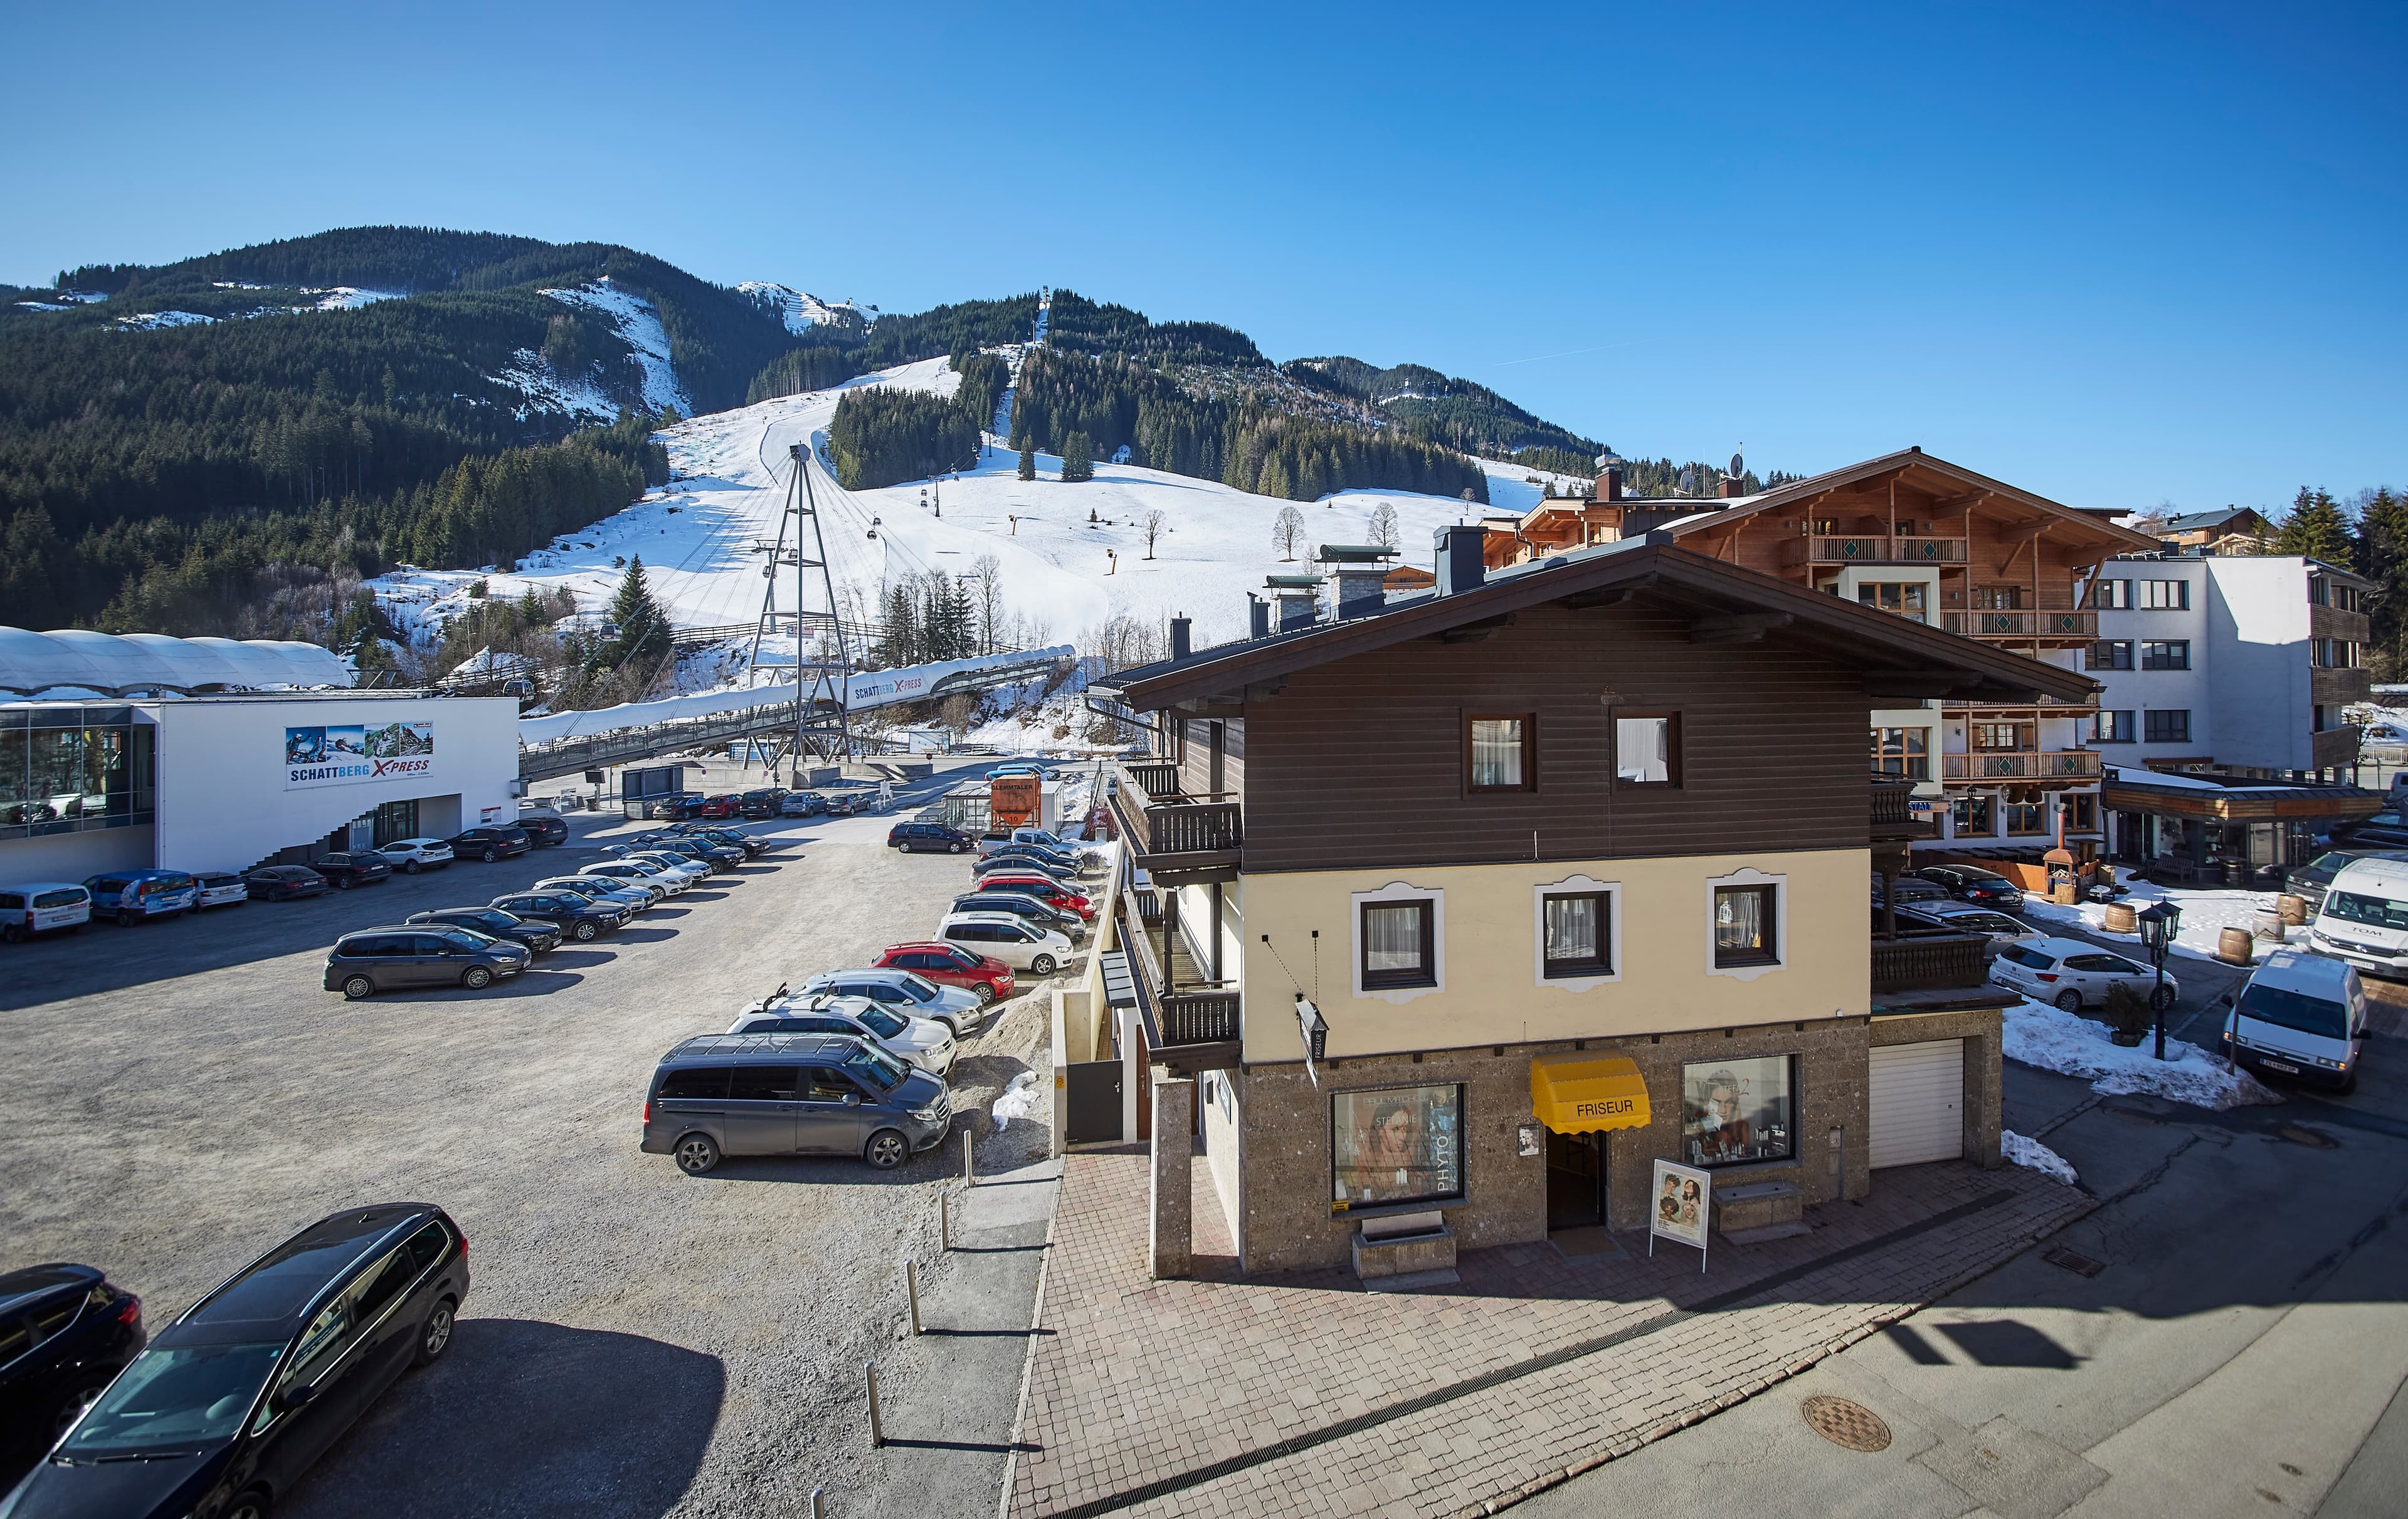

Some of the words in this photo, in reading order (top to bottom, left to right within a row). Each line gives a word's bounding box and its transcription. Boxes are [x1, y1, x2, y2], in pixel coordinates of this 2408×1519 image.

[855, 684, 894, 700] SCHATTBERG
[894, 678, 921, 693] X-PRESS
[290, 764, 370, 782] SCHATTBERG
[371, 759, 430, 777] X-PRESS
[2352, 927, 2382, 937] TOM
[1387, 1095, 1428, 1103] MITCHELL
[1577, 1100, 1634, 1117] FRISEUR
[1376, 1115, 1417, 1126] STEFANIE
[1437, 1136, 1449, 1191] PHYTO
